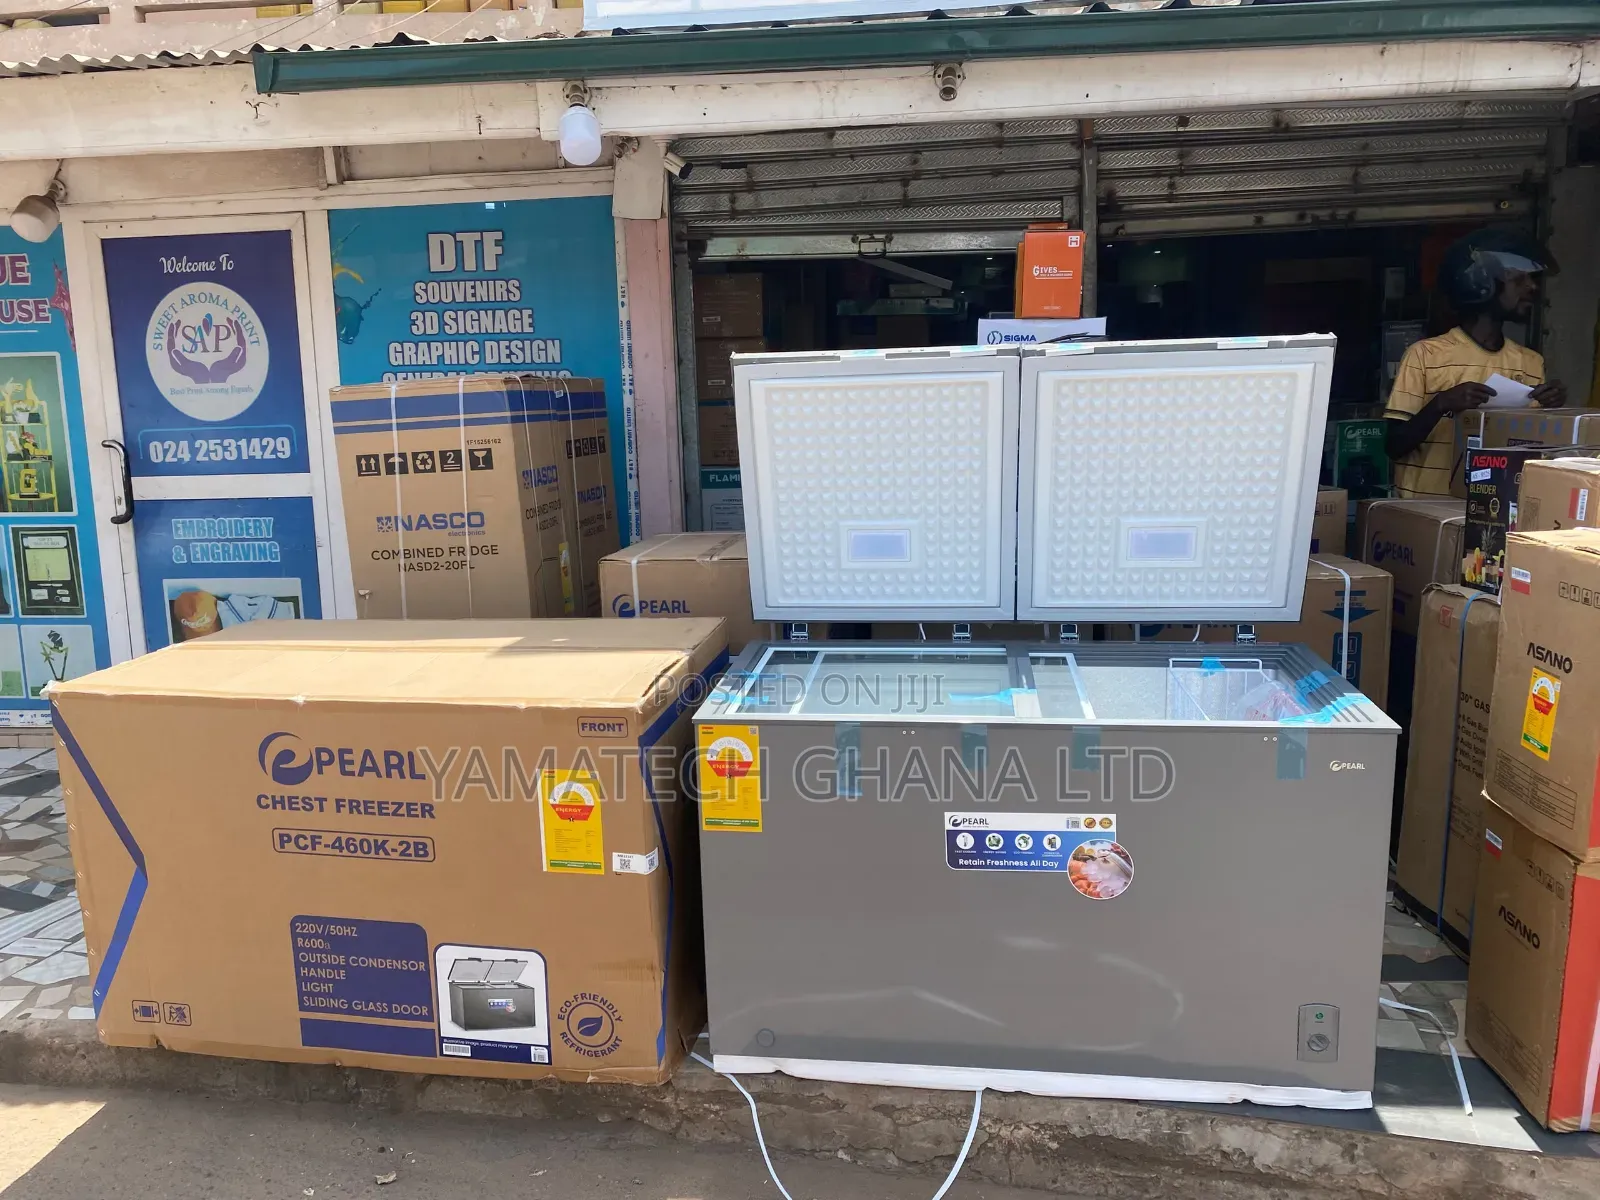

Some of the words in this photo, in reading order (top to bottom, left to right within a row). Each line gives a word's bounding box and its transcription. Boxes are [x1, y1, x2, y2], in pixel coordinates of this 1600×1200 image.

[428, 230, 503, 273] DTF
[159, 256, 216, 274] Welcome
[219, 253, 234, 271] To
[1033, 265, 1058, 277] GIVES
[414, 279, 521, 304] SOUVENIRS
[153, 303, 179, 351] SWEET
[180, 292, 229, 310] AROMA
[230, 305, 260, 346] PRINT
[410, 310, 438, 335] 3D
[443, 308, 534, 335] SIGNAGE
[1004, 334, 1036, 342] SIGMA
[388, 340, 480, 366] GRAPHIC
[484, 339, 561, 365] DESIGN
[1357, 427, 1382, 436] PEARL
[149, 440, 191, 463] 024
[194, 436, 291, 461] 2531429
[1472, 455, 1508, 469] ASANO
[1469, 483, 1498, 495] BLENDER
[171, 517, 274, 540] EMBROIDERY
[394, 511, 486, 532] NASCO
[172, 545, 187, 563] &
[191, 542, 281, 563] ENGRAVING
[371, 547, 445, 561] COMBINED
[448, 544, 499, 557] FRDGE
[639, 599, 691, 614] PEARL
[1526, 641, 1573, 674] ASANO
[1474, 698, 1491, 714] GAS
[581, 721, 625, 733] FRONT
[314, 746, 427, 781] PEARL
[1341, 762, 1366, 770] PEARL
[256, 793, 328, 814] CHEST
[334, 797, 437, 820] FREEZER
[962, 817, 990, 826] PEARL
[278, 832, 431, 859] PCF-460K-2B
[959, 858, 985, 867] Retain
[986, 859, 1028, 867] Freshness
[1042, 860, 1059, 869] Day
[1498, 904, 1541, 950] ASANO
[297, 937, 331, 950] R600a
[299, 952, 346, 966] OUTSIDE
[349, 956, 426, 972] CONDENSOR
[300, 966, 347, 980] HANDLE
[301, 981, 334, 993] LIGHT
[303, 996, 349, 1010] SLIDING
[351, 1000, 389, 1013] GLASS
[392, 1004, 429, 1017] DOOR
[557, 991, 624, 1023] ECO-FRIENDLY
[559, 1031, 623, 1058] REFRIGERANT
